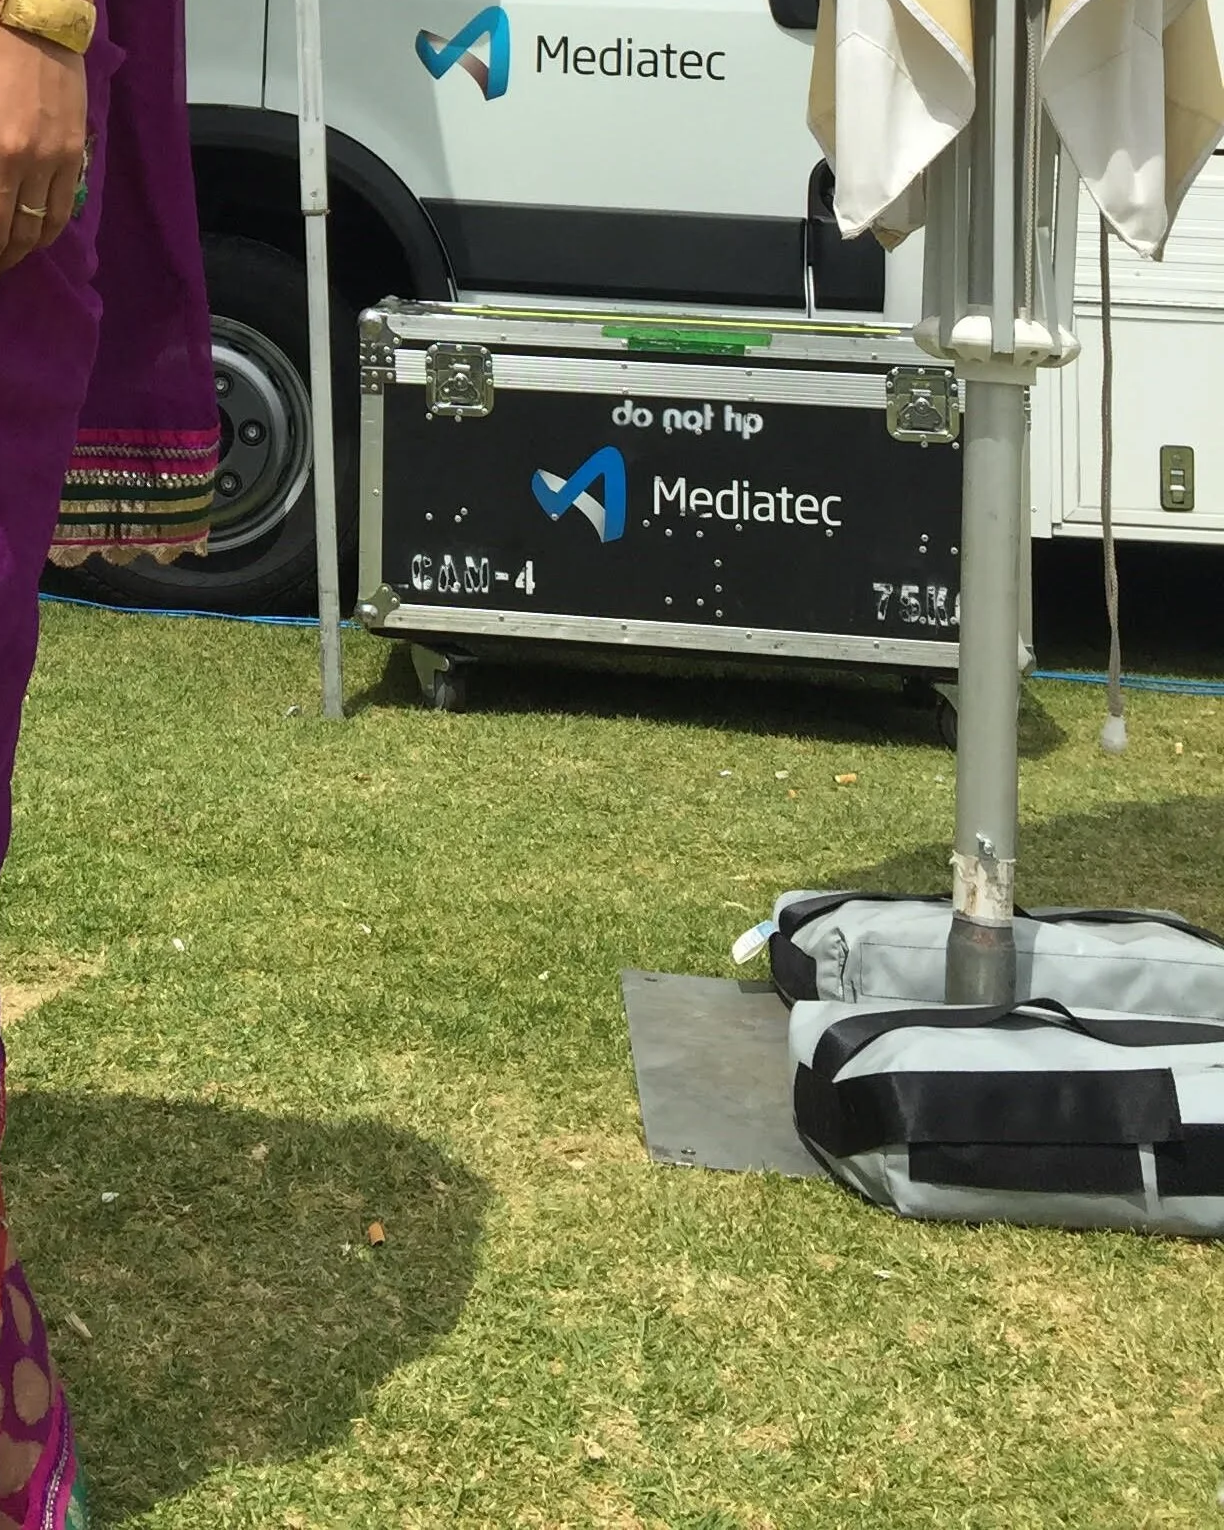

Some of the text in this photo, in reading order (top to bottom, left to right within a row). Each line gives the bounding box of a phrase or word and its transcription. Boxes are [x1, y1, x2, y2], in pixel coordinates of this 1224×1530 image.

[536, 34, 726, 81] Mediatec
[611, 399, 654, 428] do
[662, 402, 715, 432] not
[653, 476, 842, 527] Mediatec
[872, 582, 960, 627] 75K
